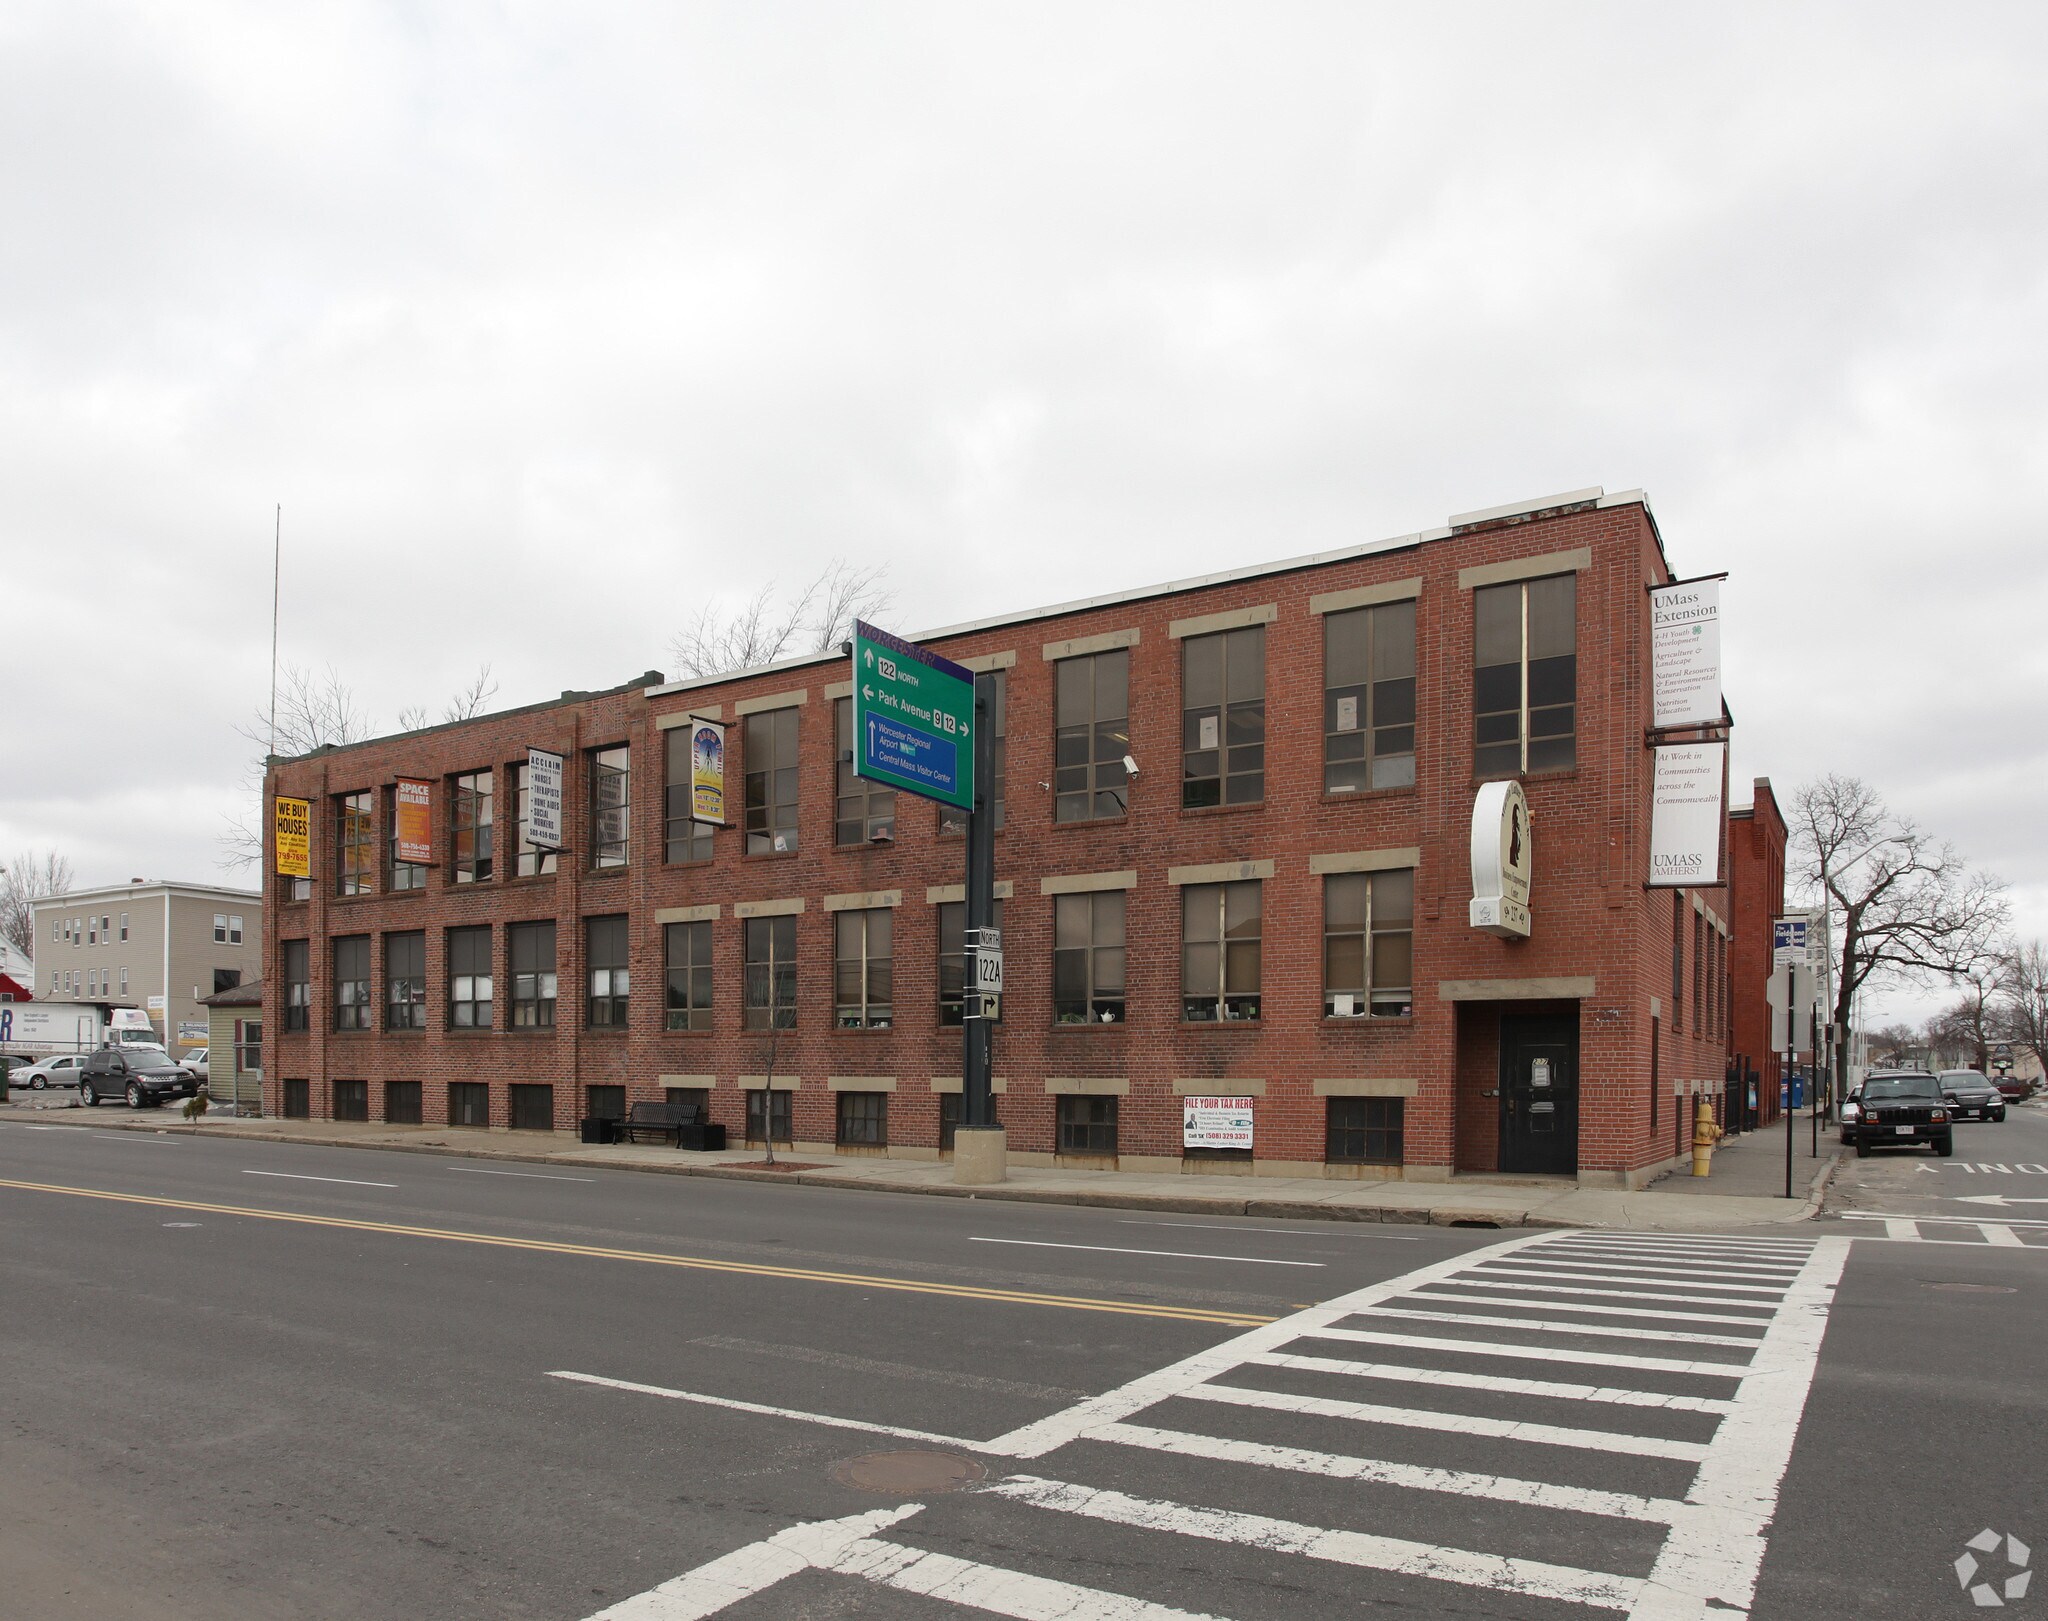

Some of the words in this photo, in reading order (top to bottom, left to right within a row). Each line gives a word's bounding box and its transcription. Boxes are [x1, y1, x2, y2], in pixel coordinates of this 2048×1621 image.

[1655, 593, 1699, 609] UMass
[1655, 605, 1717, 623] Extension
[1670, 629, 1690, 638] Youth
[1655, 636, 1699, 649] Development
[1655, 649, 1693, 660] Agriculture
[1655, 658, 1691, 668] Landscape
[879, 660, 895, 678] 122
[898, 670, 919, 687] NORTH
[1656, 670, 1682, 680] Natural
[1683, 666, 1717, 676] Resources
[1664, 673, 1716, 687] Environmental
[1656, 685, 1701, 696] Conservation
[1656, 698, 1688, 708] Nutrition
[879, 689, 898, 709] Park
[901, 699, 931, 721] Avenue
[935, 712, 941, 725] 9
[945, 716, 955, 731] 12
[1656, 706, 1691, 716] Education
[879, 723, 906, 740] Worcester
[907, 733, 931, 750] Regional
[879, 736, 898, 750] Airport
[1658, 752, 1668, 761] At
[1671, 751, 1692, 760] Work
[1694, 751, 1702, 760] in
[531, 756, 560, 771] ACCLAIM
[879, 751, 900, 766] Central
[917, 764, 932, 777] Visitor
[934, 770, 951, 783] Center
[1658, 766, 1711, 776] Communities
[535, 773, 551, 785] NURSES
[400, 782, 429, 796] SPACE
[534, 785, 560, 798] THERAPISTS
[1657, 783, 1681, 791] across
[1683, 780, 1696, 789] the
[400, 793, 429, 805] AVAILABLE
[534, 797, 546, 808] HOME
[547, 800, 559, 811] AIDES
[1656, 794, 1719, 805] Commonwealth
[278, 803, 290, 816] WE
[293, 804, 307, 818] BUY
[534, 807, 549, 819] SOCIAL
[278, 817, 308, 836] HOUSES
[534, 817, 554, 829] WORKERS
[278, 851, 308, 862] 799-7655
[1654, 853, 1702, 867] UMASS
[1654, 866, 1701, 876] AMHERST
[981, 930, 1000, 946] NORTH
[979, 958, 1001, 983] 122A
[1185, 1098, 1199, 1109] FILE
[1200, 1098, 1219, 1109] YOUR
[1221, 1098, 1234, 1109] TAX
[1235, 1098, 1254, 1109] HERE
[1206, 1132, 1222, 1140] (508)
[1915, 1163, 2048, 1174] ONLY
